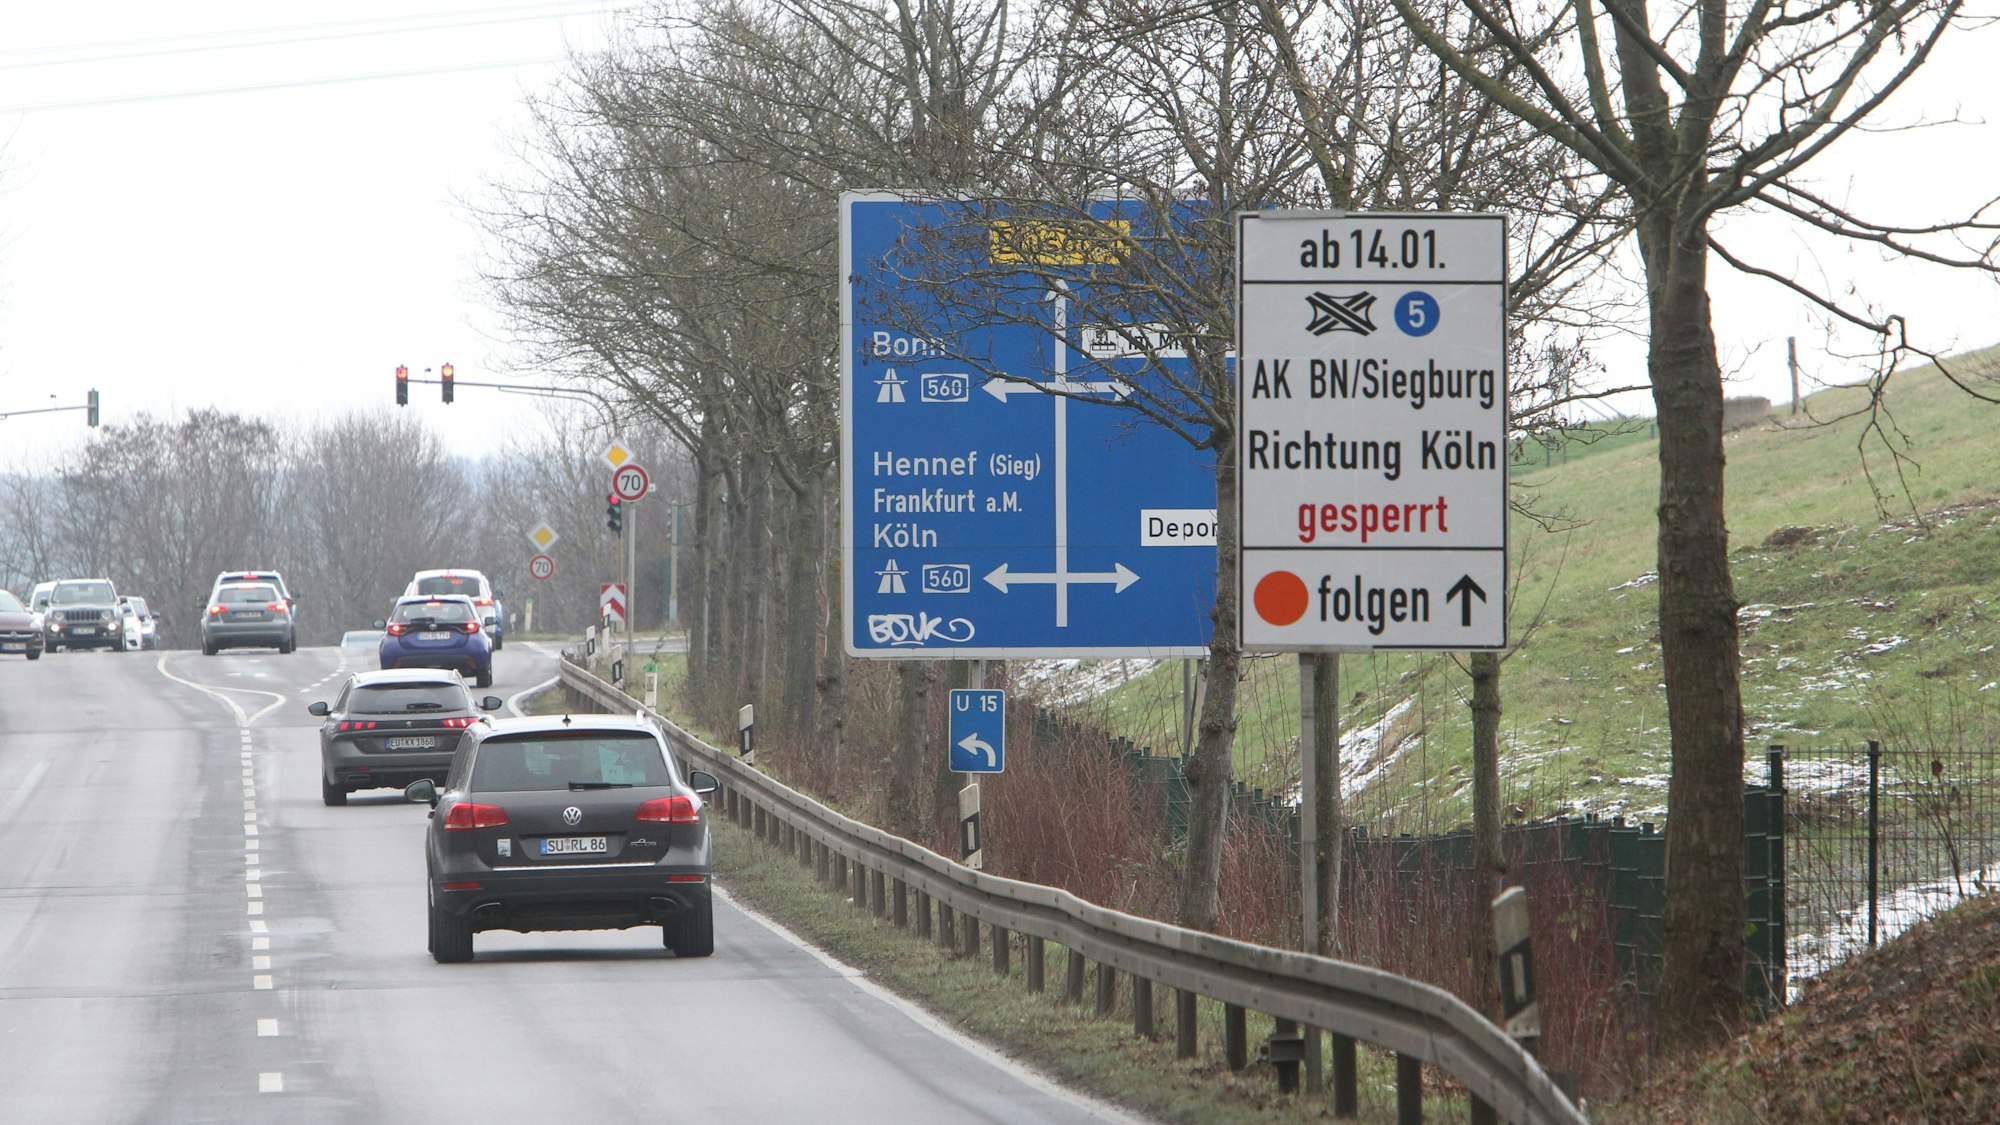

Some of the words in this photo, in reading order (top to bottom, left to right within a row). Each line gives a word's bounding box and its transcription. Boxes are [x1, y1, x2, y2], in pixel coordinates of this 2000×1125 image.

[1300, 229, 1340, 269] ab
[1350, 229, 1446, 269] 14.01.
[1408, 300, 1426, 329] 5
[873, 331, 946, 357] Bonn
[928, 379, 963, 397] 560
[1252, 359, 1292, 399] AK
[1310, 359, 1495, 410] BN/Siegburg
[873, 451, 977, 476] Hennef
[989, 453, 1041, 481] (Sieg)
[1249, 430, 1401, 481] Richtung
[1422, 430, 1496, 470] Köln
[621, 475, 641, 491] 70
[873, 489, 976, 513] Frankfurt
[986, 492, 1023, 513] a.M.
[1298, 496, 1448, 544] gesperrt
[873, 523, 938, 548] Köln
[535, 561, 549, 573] 70
[929, 569, 964, 588] 560
[1318, 575, 1429, 635] folgen
[956, 695, 969, 712] U
[980, 695, 998, 712] 15
[391, 739, 400, 747] EU
[417, 737, 434, 746] 1868
[548, 840, 563, 851] SU
[571, 839, 587, 851] RL
[590, 838, 606, 850] 86
